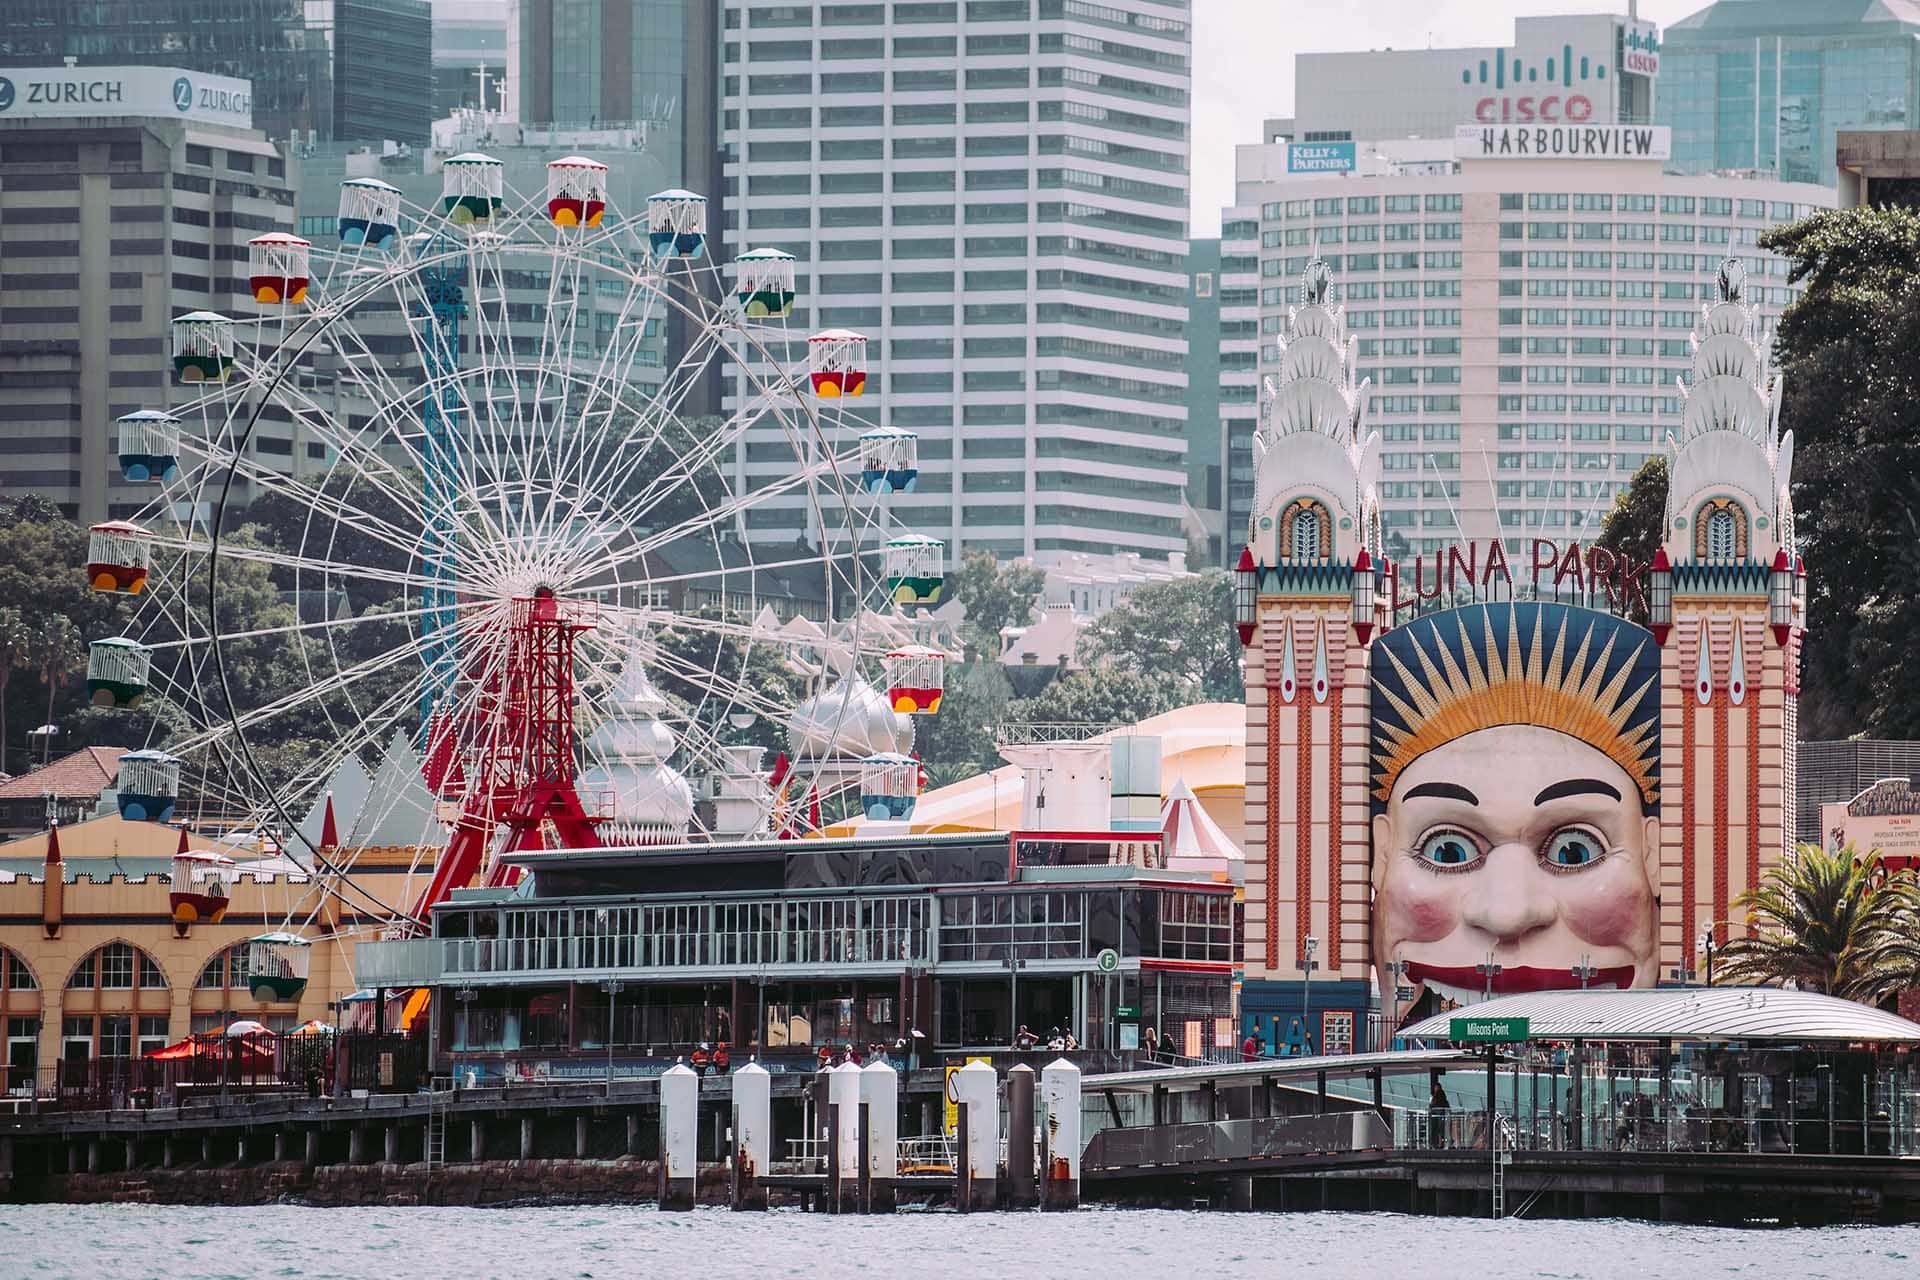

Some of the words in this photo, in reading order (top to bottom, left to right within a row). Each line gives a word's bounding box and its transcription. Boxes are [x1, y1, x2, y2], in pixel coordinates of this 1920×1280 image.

[1627, 53, 1658, 73] CISCO
[27, 81, 122, 103] ZURICH
[199, 88, 251, 113] ZURICH
[1475, 95, 1592, 123] CISCO
[1481, 127, 1653, 154] HARBOURVIEW
[1293, 158, 1351, 169] PARTNERS
[1391, 537, 1513, 611] LUNA
[1532, 538, 1650, 614] PARK
[1105, 954, 1113, 967] F
[1467, 1022, 1491, 1036] Milsons
[1492, 1022, 1509, 1036] Point
